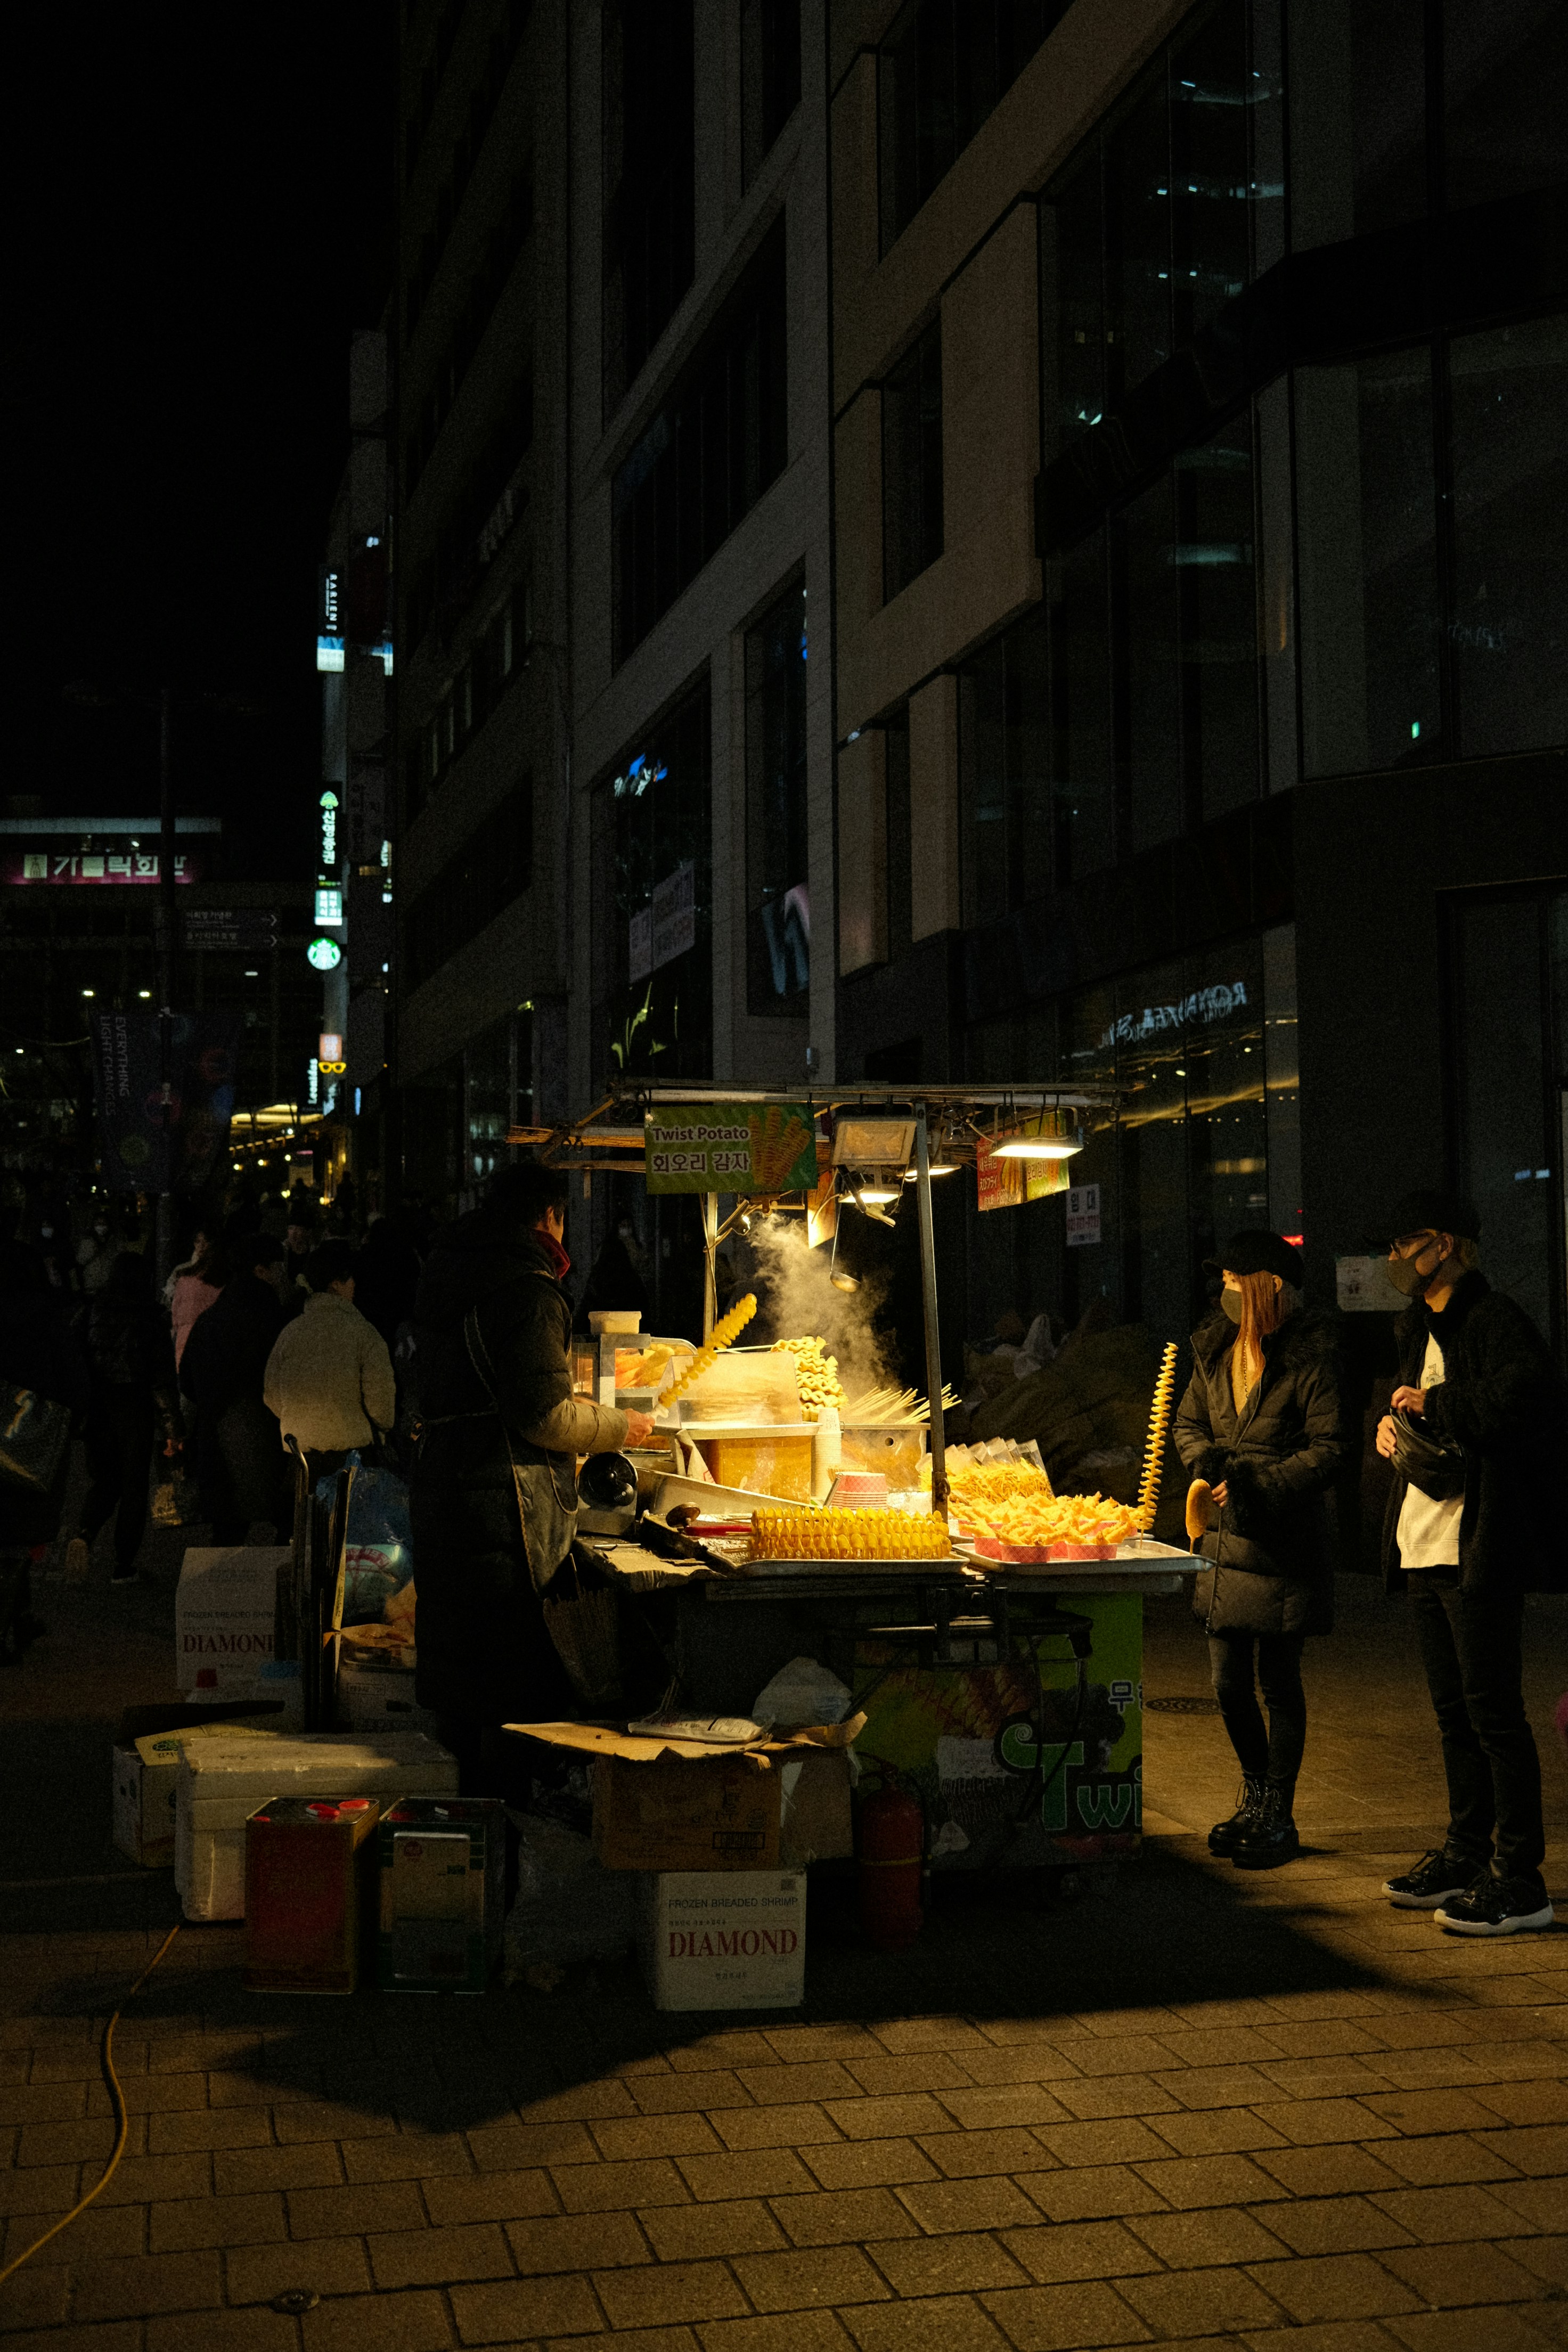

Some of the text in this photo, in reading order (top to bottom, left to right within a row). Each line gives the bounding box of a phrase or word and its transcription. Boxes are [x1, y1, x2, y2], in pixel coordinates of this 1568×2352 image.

[100, 1015, 113, 1054] LIGHT
[115, 1016, 130, 1098] EVERYTHING
[307, 1059, 317, 1104] Leonidas
[652, 1127, 749, 1141] Twist Potato
[653, 1153, 749, 1172] 회오리 감자
[980, 1174, 998, 1191] えびフライ
[668, 1897, 798, 1908] FROZEN BREADED SHRIMP
[668, 1929, 798, 1957] DIAMOND
